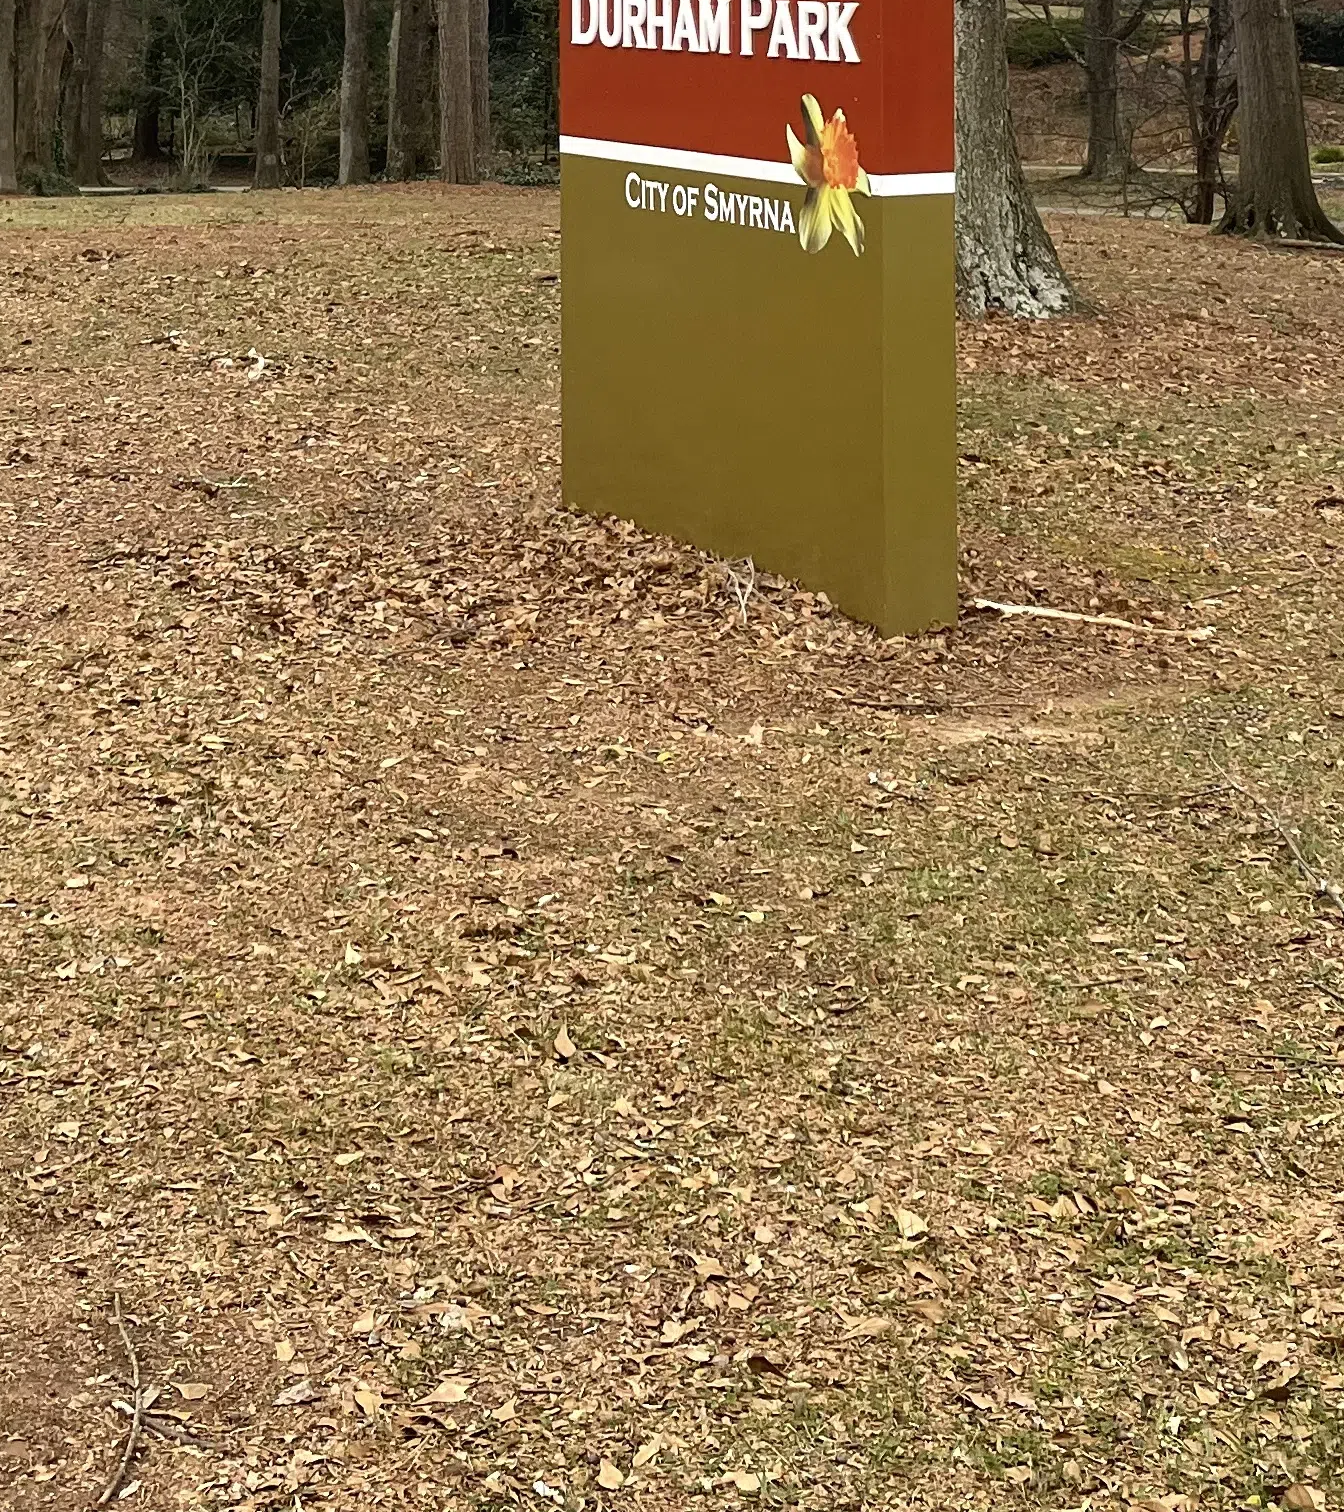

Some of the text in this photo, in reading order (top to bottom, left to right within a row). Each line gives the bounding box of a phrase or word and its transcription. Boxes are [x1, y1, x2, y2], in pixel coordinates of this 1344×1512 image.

[625, 172, 797, 234] CITY OF SMYRNA
